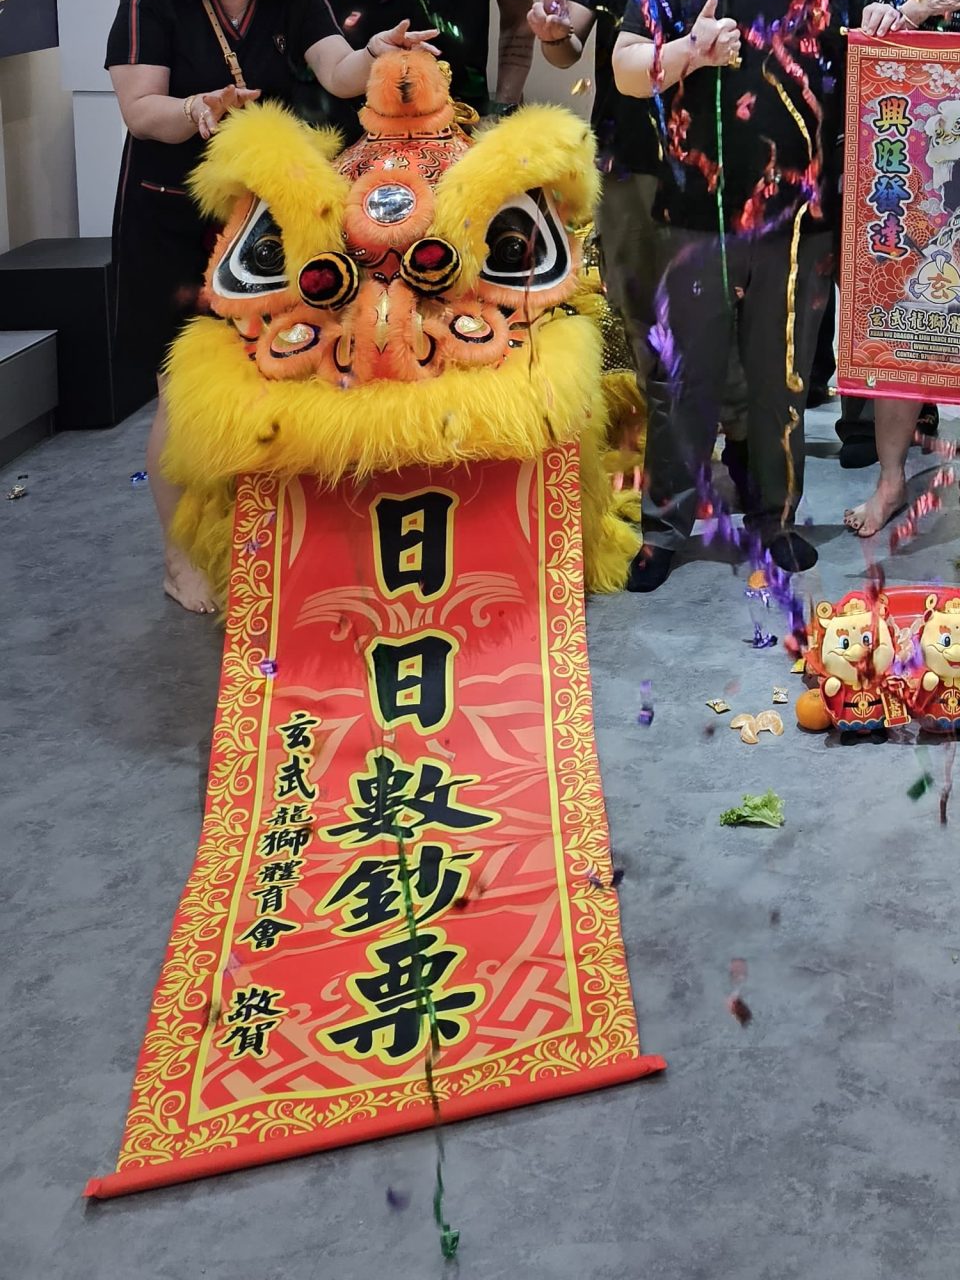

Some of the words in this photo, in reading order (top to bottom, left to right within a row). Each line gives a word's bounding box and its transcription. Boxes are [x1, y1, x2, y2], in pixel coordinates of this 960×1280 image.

[868, 96, 913, 260] 興旺發達
[927, 272, 952, 300] 玄
[323, 490, 496, 1061] 日日數鈔票
[222, 986, 286, 1058] 敬賀
